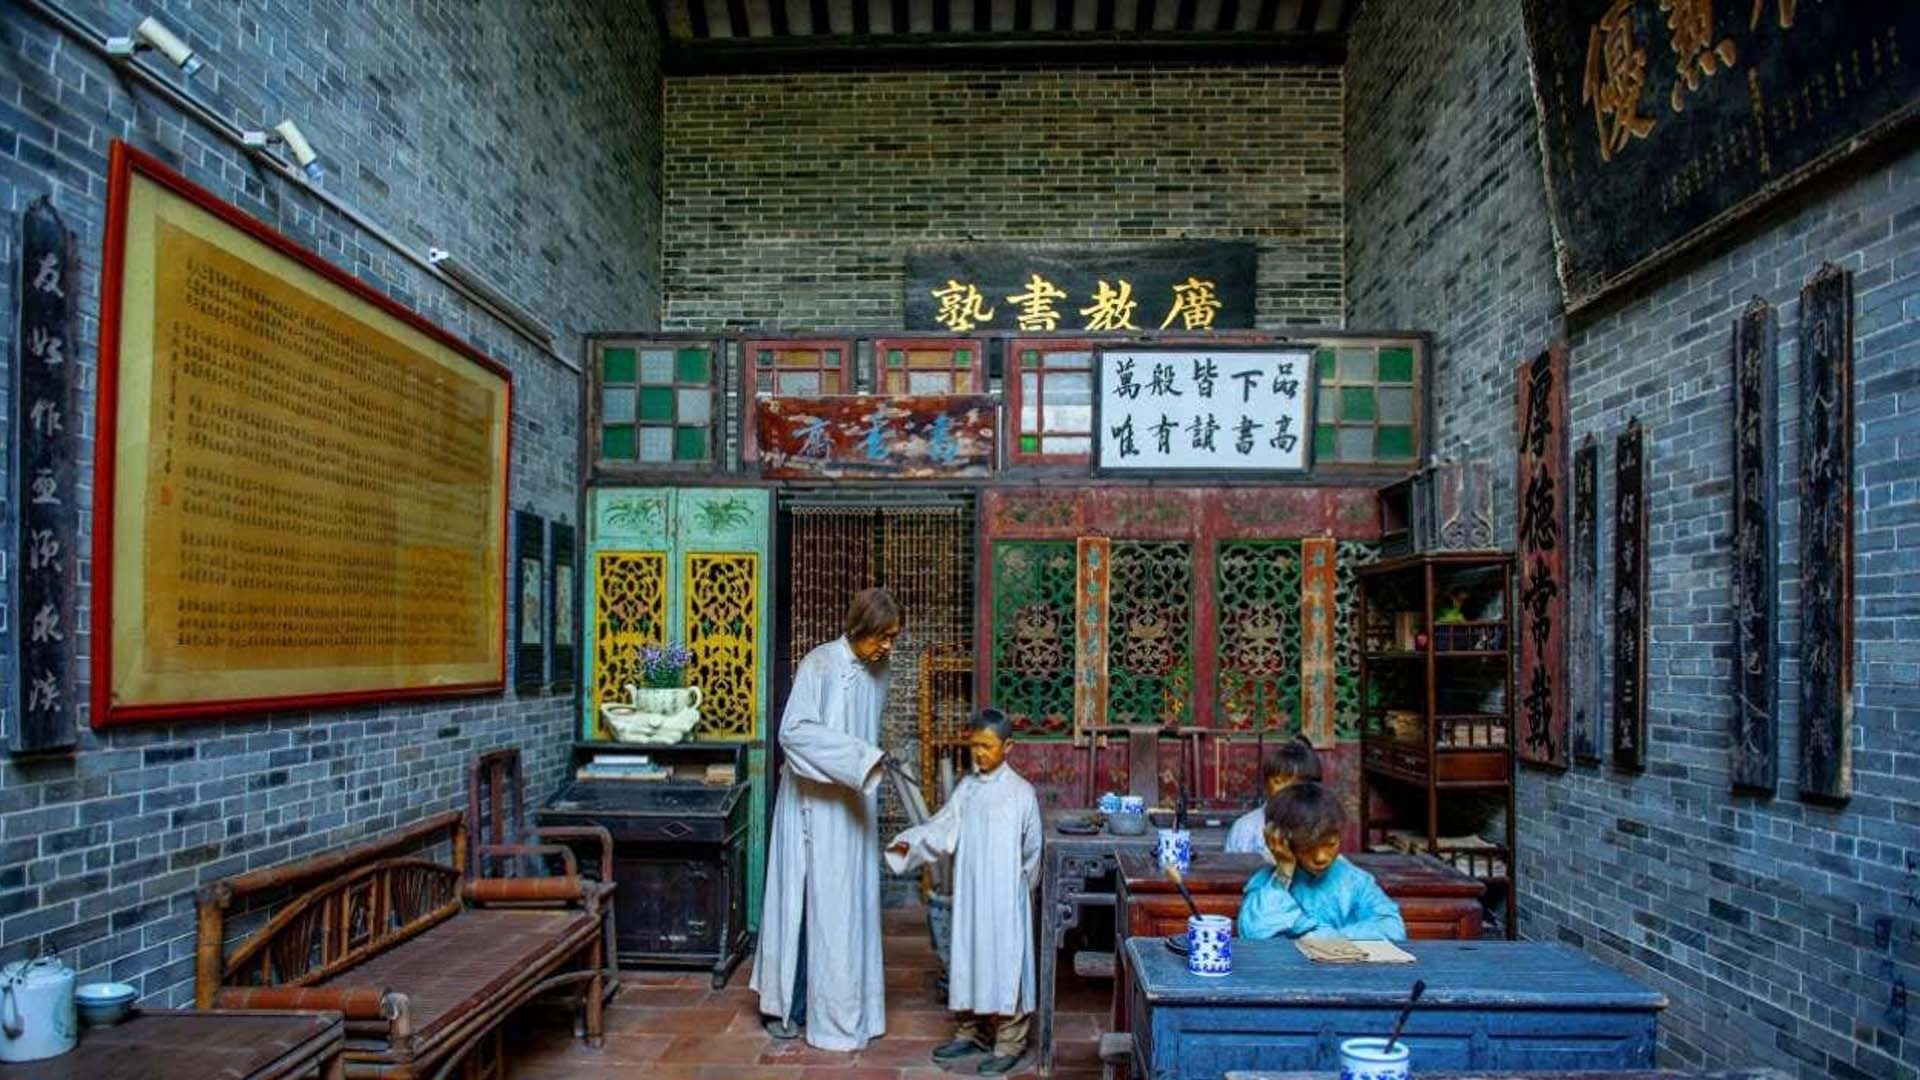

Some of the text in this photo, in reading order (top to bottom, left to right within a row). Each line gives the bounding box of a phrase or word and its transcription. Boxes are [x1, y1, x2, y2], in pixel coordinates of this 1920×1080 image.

[1112, 357, 1299, 402] 萬般皆下品
[1111, 413, 1298, 459] 唯有讀書高
